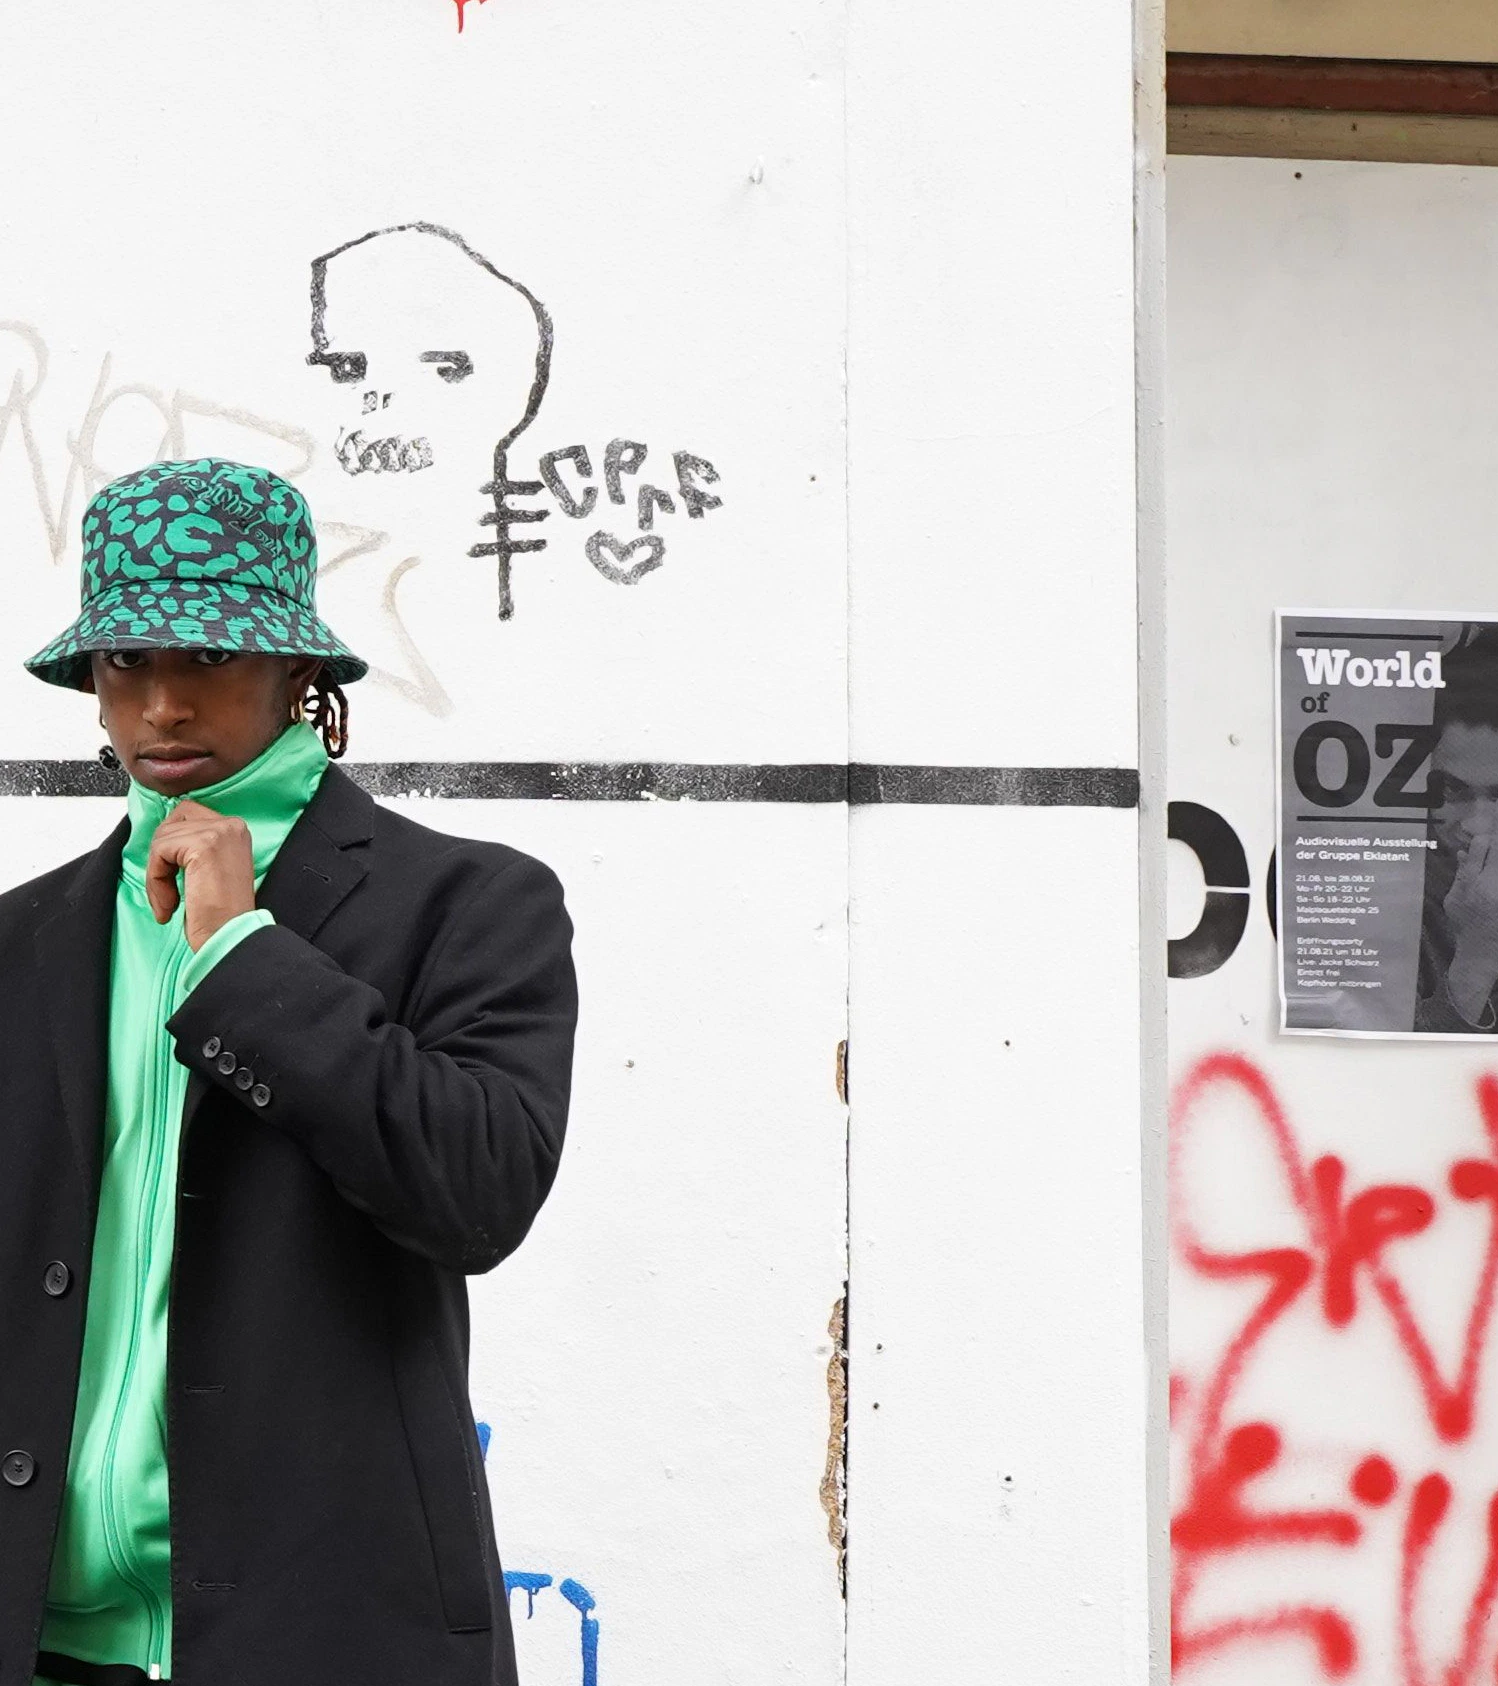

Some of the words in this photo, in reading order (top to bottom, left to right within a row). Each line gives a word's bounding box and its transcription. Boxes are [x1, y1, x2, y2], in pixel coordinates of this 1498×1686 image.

[1295, 647, 1447, 689] World
[1299, 690, 1331, 714] of
[1292, 719, 1446, 809] OZ
[1295, 836, 1371, 847] Audiovisuelle
[1372, 837, 1438, 850] Ausstellung
[1295, 850, 1316, 860] der
[1318, 850, 1361, 862] Gruppe
[1296, 915, 1321, 924] Berlin
